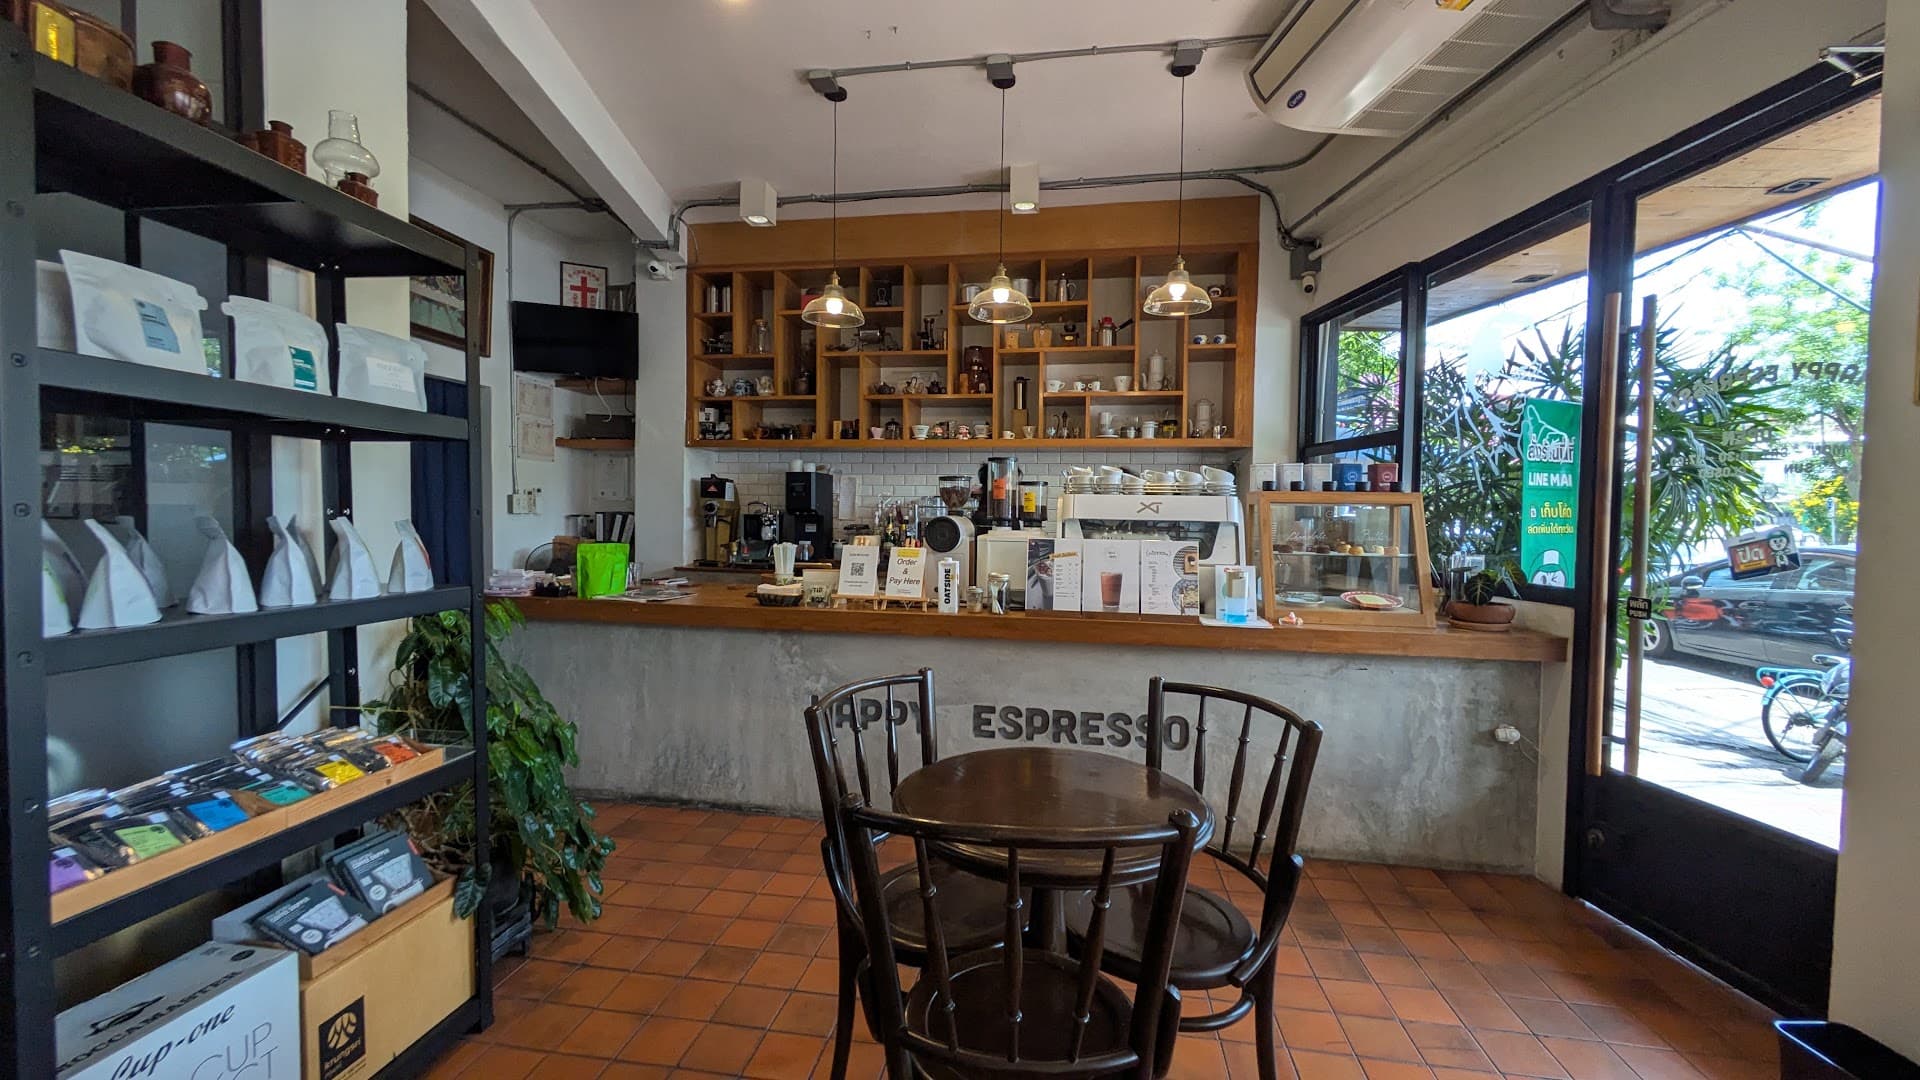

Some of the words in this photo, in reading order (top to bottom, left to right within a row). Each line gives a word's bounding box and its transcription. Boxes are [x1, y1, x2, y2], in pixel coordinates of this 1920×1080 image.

[1528, 472, 1549, 486] LINE
[897, 558, 918, 566] Order
[889, 577, 902, 586] Pay
[903, 577, 920, 585] Here
[811, 695, 921, 734] APPY
